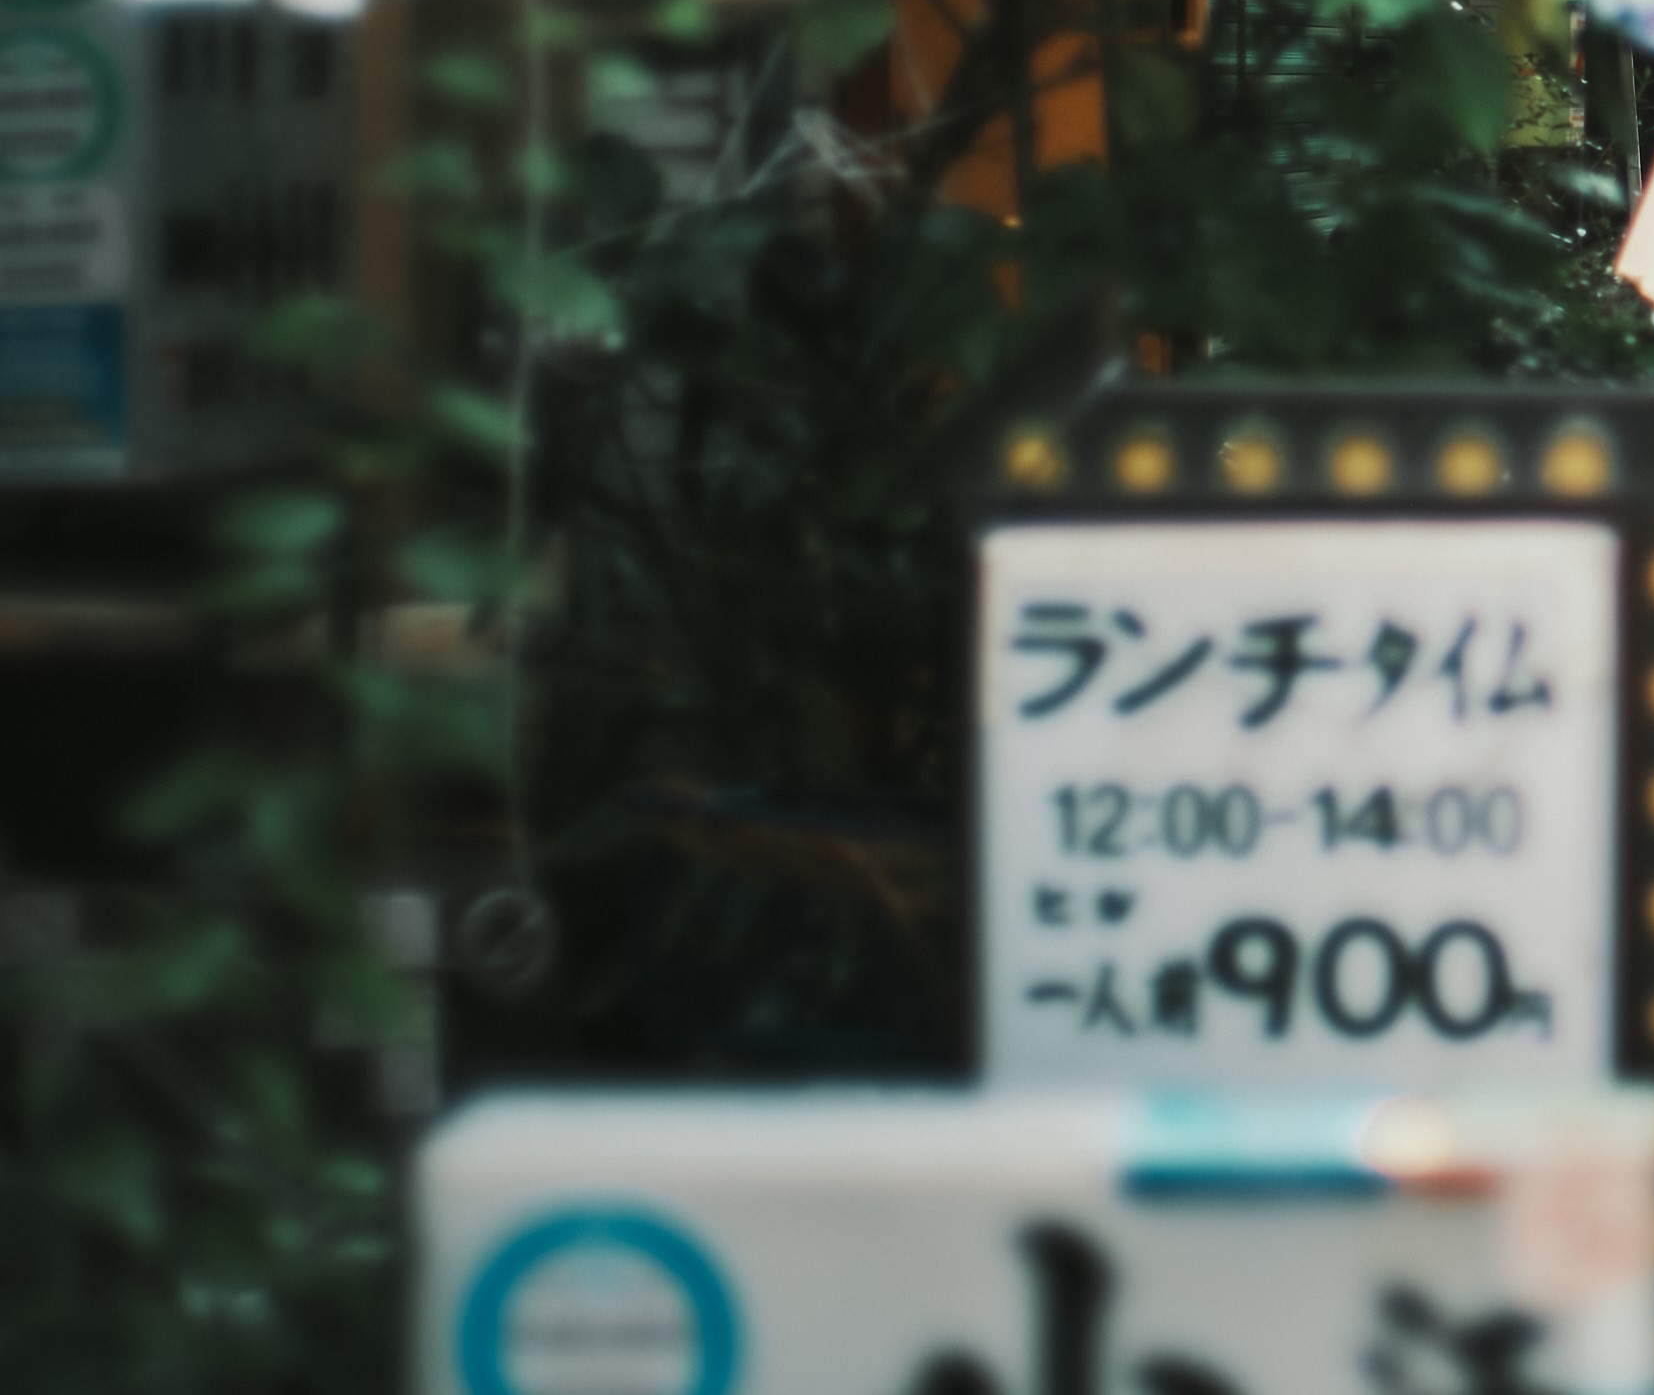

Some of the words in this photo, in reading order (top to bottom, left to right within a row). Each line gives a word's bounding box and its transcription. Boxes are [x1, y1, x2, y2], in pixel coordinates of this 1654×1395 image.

[1010, 599, 1556, 732] ランチタイム
